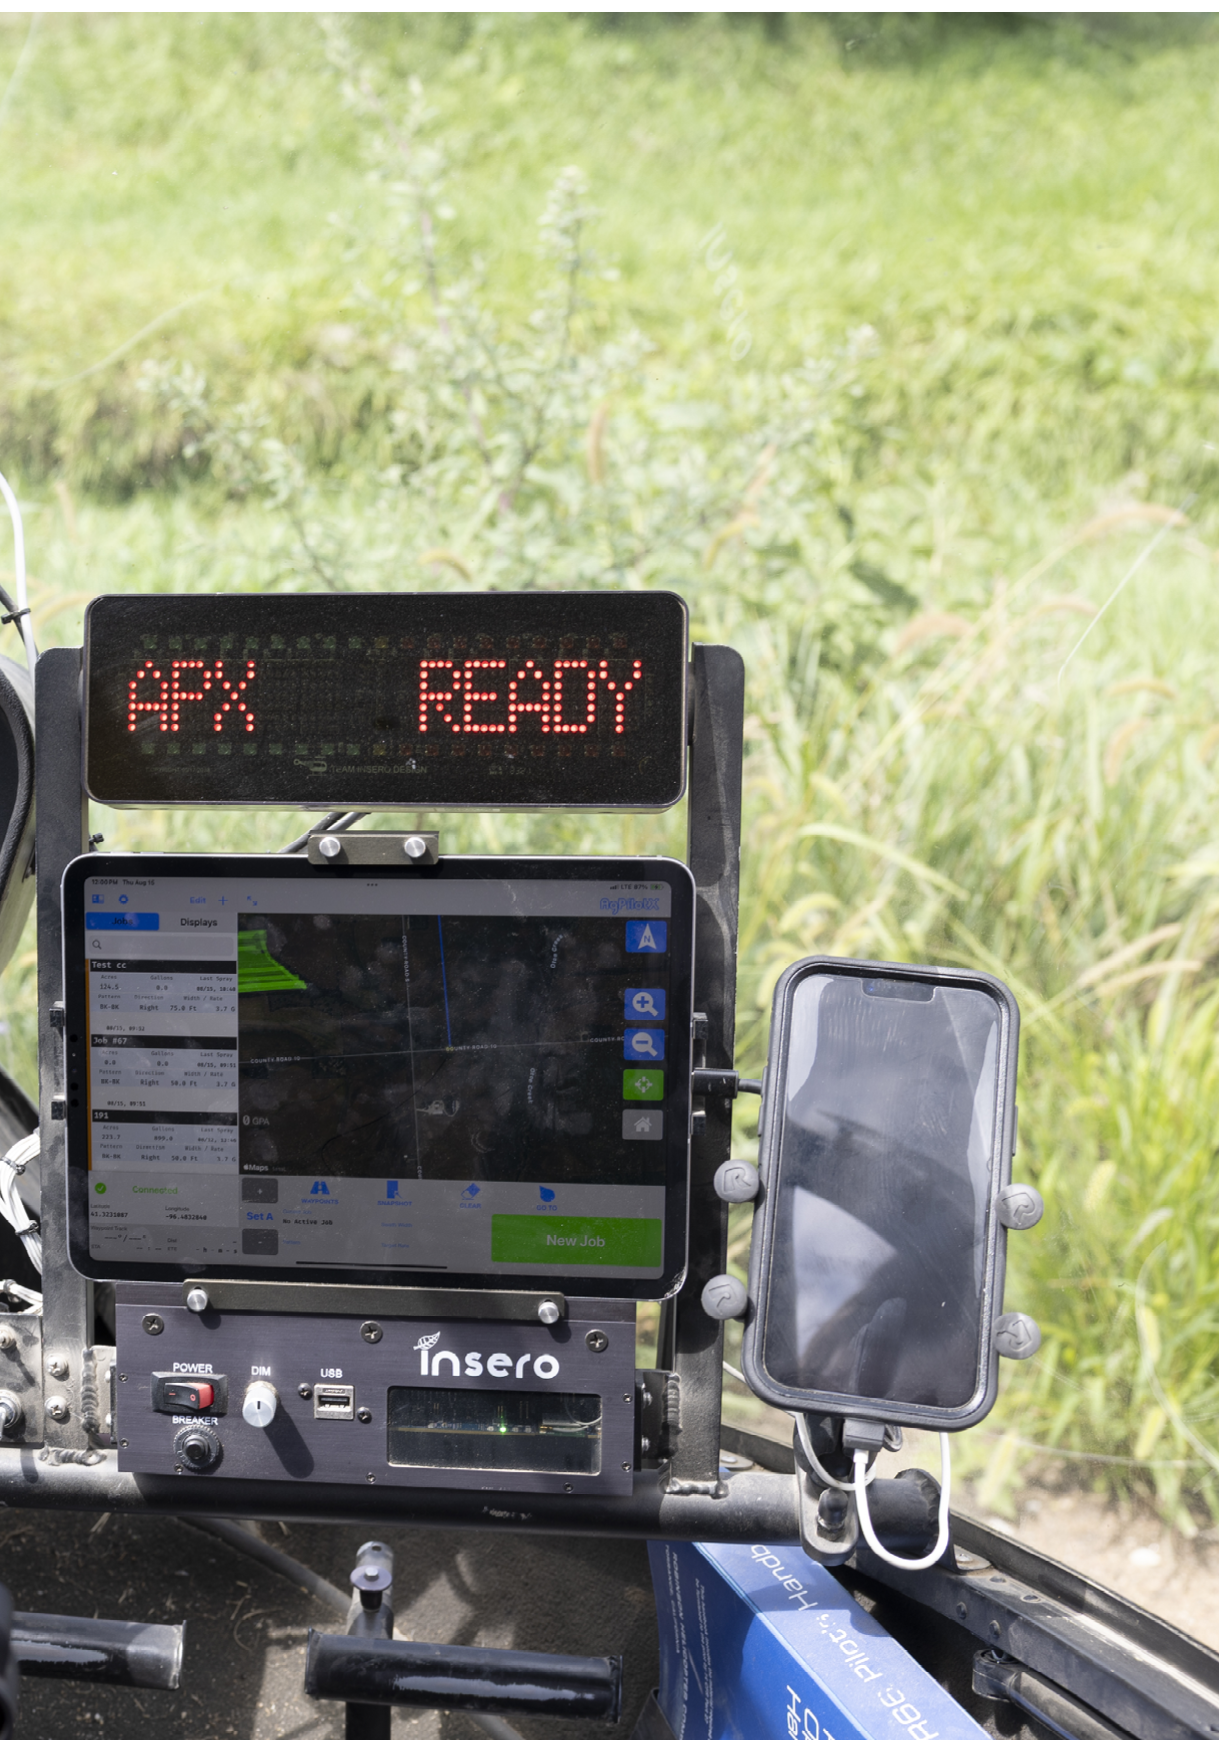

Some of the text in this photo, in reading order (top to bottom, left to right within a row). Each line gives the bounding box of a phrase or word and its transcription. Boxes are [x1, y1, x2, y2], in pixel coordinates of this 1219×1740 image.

[128, 660, 256, 732] APX
[418, 660, 642, 733] READY
[600, 898, 659, 914] AgPilotX
[181, 918, 217, 928] Displays
[249, 1164, 269, 1172] Maps
[133, 1186, 178, 1194] Connected
[246, 1212, 264, 1220] Set
[547, 1235, 605, 1247] New Job
[172, 1362, 213, 1374] POWER
[420, 1349, 559, 1380] insero
[251, 1366, 271, 1376] DIM
[320, 1368, 343, 1379] USB
[172, 1416, 218, 1426] BREAKER
